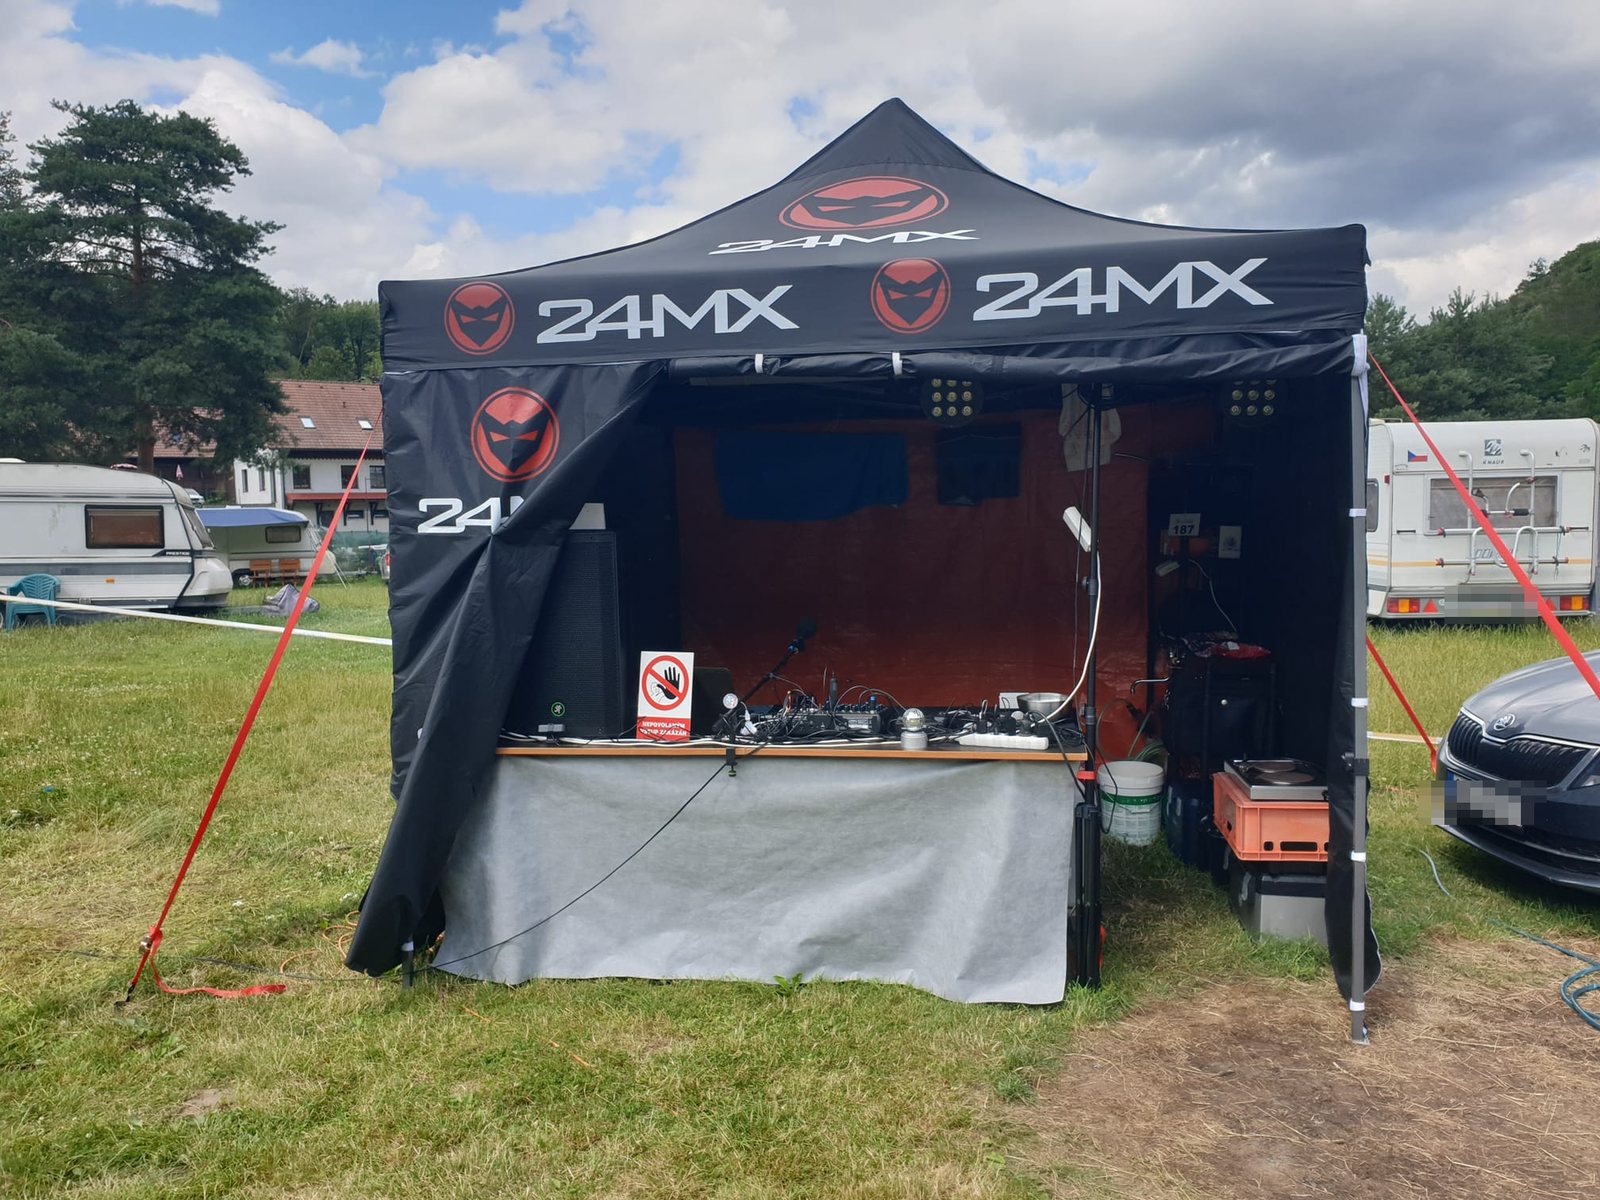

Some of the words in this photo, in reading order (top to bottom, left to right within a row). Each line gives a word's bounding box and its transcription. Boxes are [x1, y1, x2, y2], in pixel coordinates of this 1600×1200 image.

[708, 229, 981, 255] 24MX
[972, 257, 1274, 321] 24MX
[536, 284, 800, 344] 24MX
[417, 495, 525, 534] 24
[1174, 524, 1195, 535] 187
